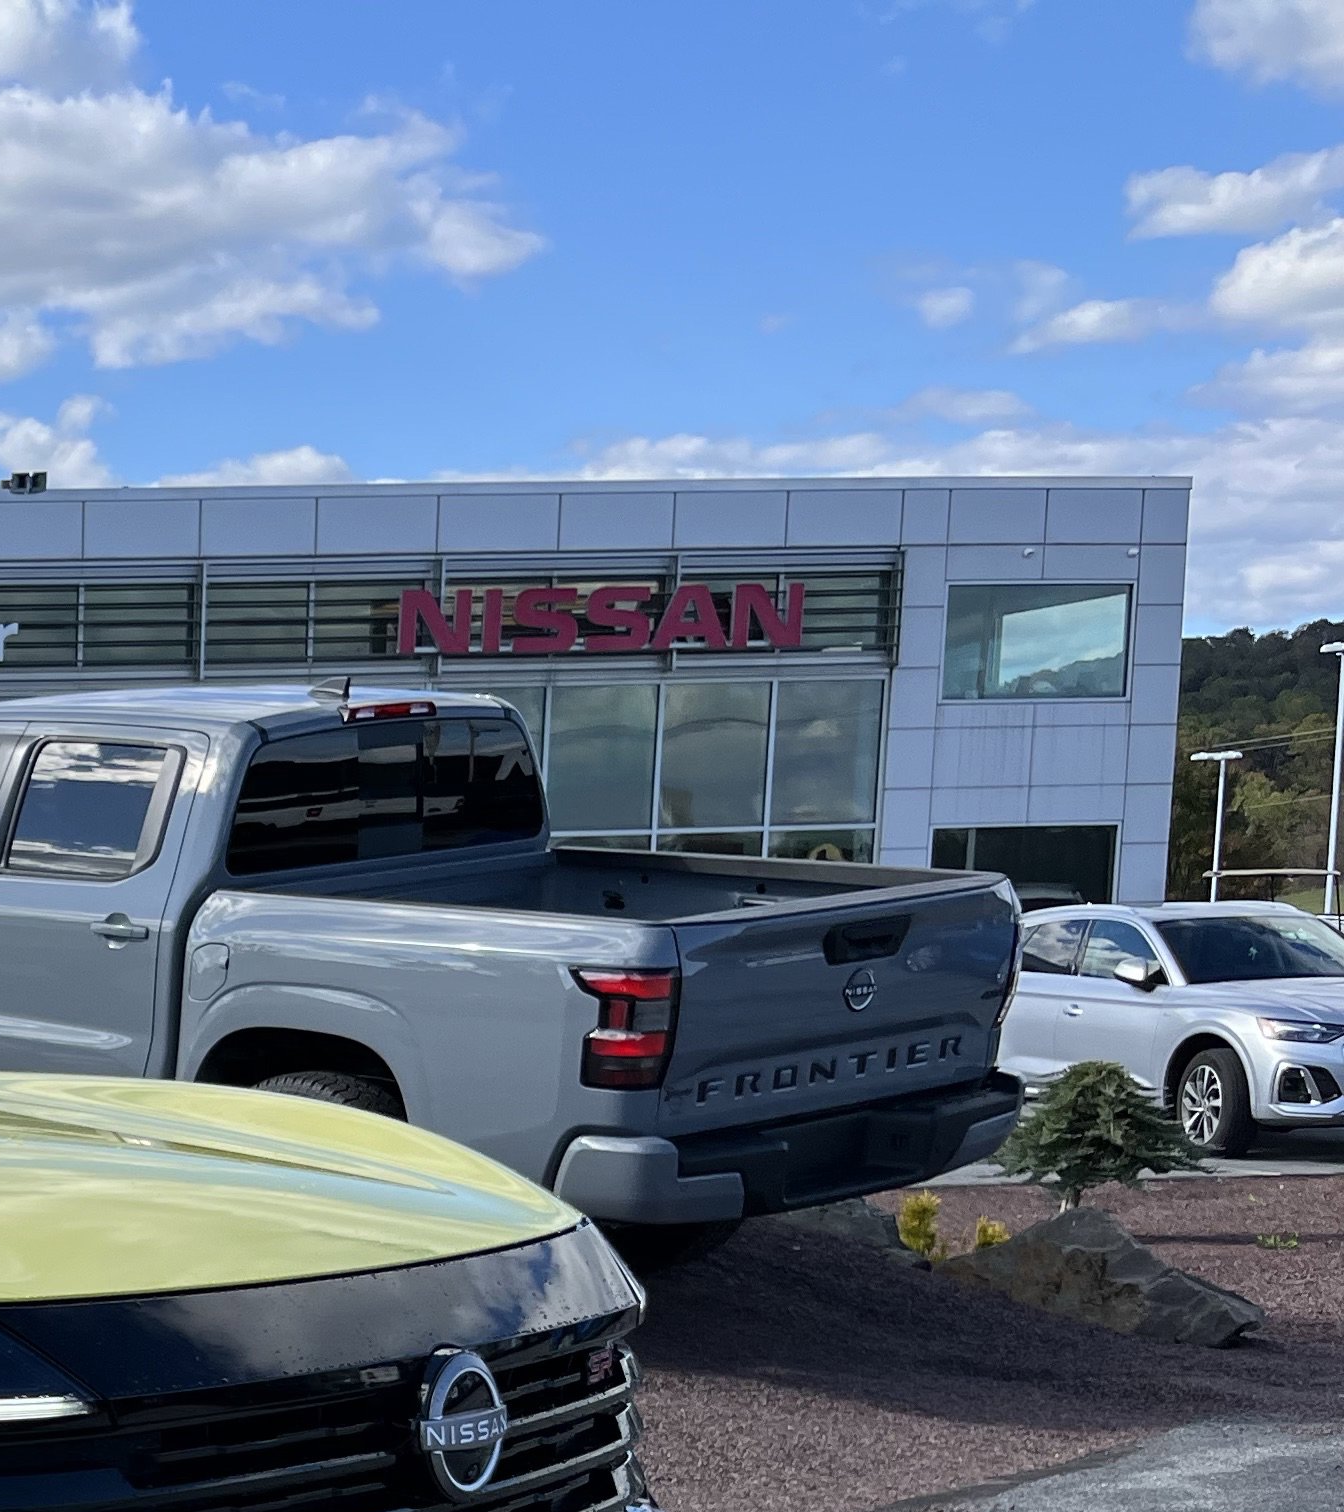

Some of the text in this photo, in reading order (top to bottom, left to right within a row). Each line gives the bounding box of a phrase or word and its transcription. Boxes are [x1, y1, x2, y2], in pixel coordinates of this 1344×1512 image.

[396, 583, 805, 654] NISSAN
[695, 1036, 962, 1107] FRONTIER
[426, 1414, 508, 1447] NISSAN
